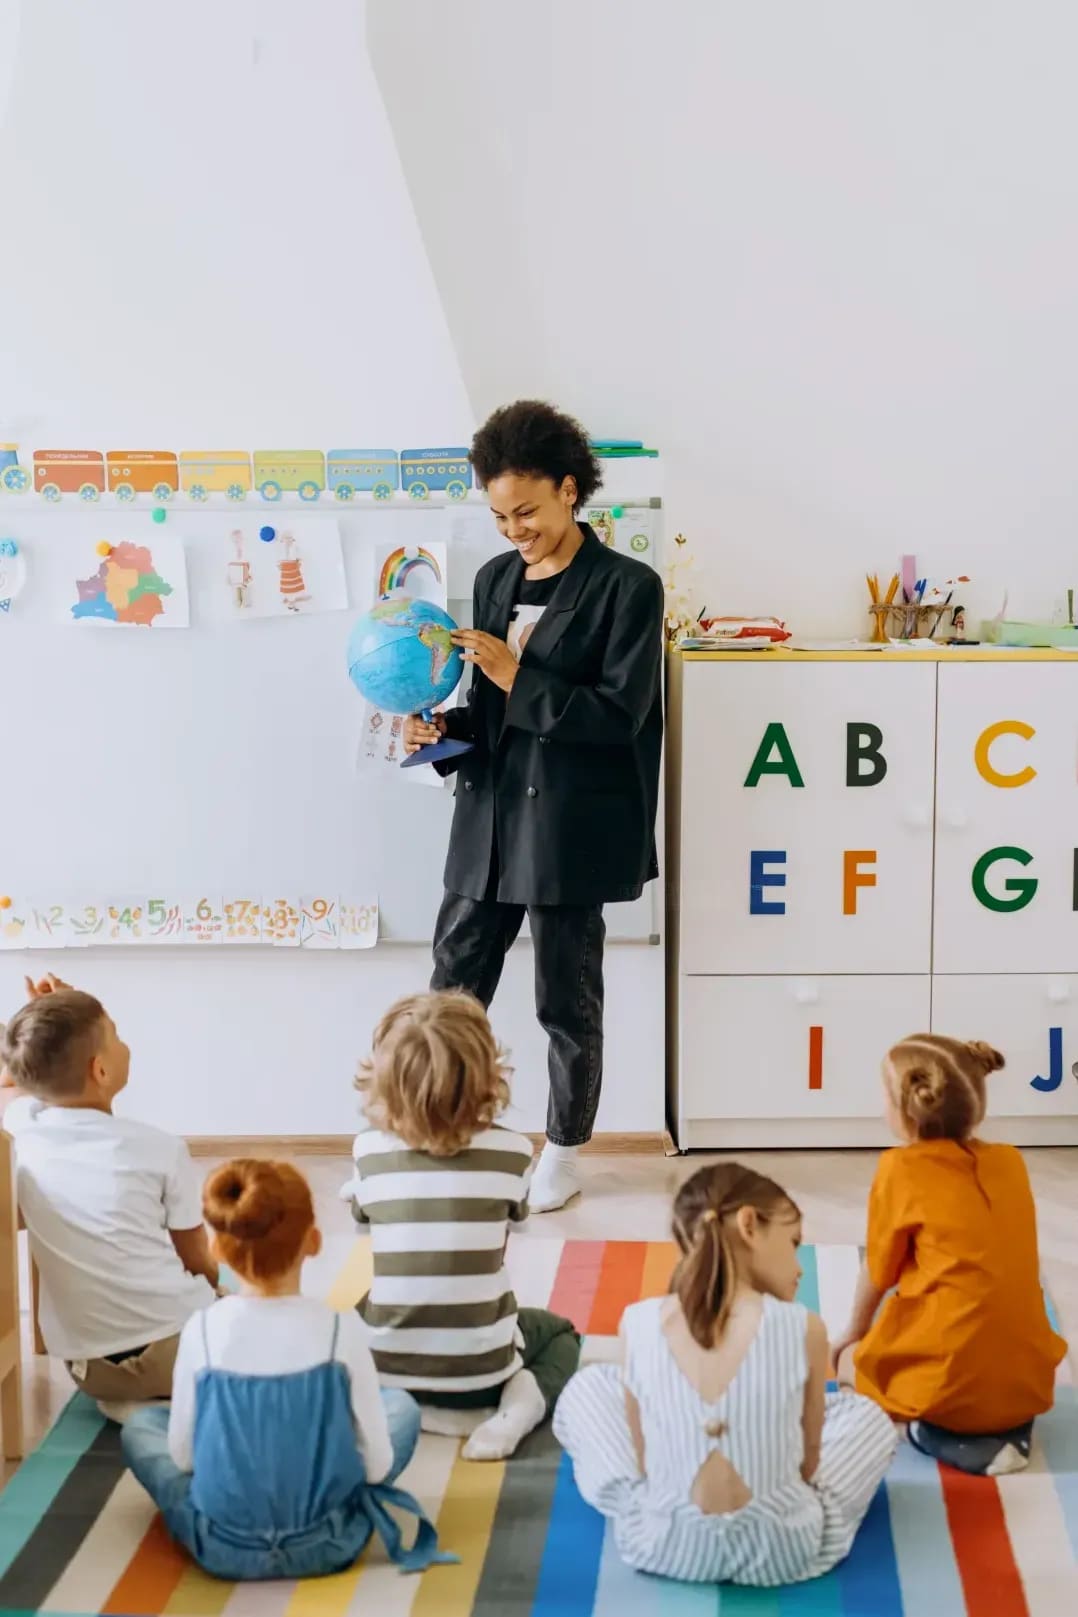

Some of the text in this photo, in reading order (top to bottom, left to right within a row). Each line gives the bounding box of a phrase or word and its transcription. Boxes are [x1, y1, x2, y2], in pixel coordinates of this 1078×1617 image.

[744, 723, 804, 788] A
[846, 722, 887, 787] B
[974, 720, 1037, 788] C
[49, 905, 64, 926] 2
[83, 906, 97, 926] 3
[118, 907, 134, 928] 4
[147, 899, 167, 926] 5
[196, 897, 212, 921] 6
[233, 900, 253, 922] 7
[274, 908, 289, 929] 8
[312, 899, 328, 921] 9
[750, 851, 787, 914] E
[843, 850, 877, 915] F
[971, 847, 1038, 913] G
[808, 1026, 1063, 1092] I J
